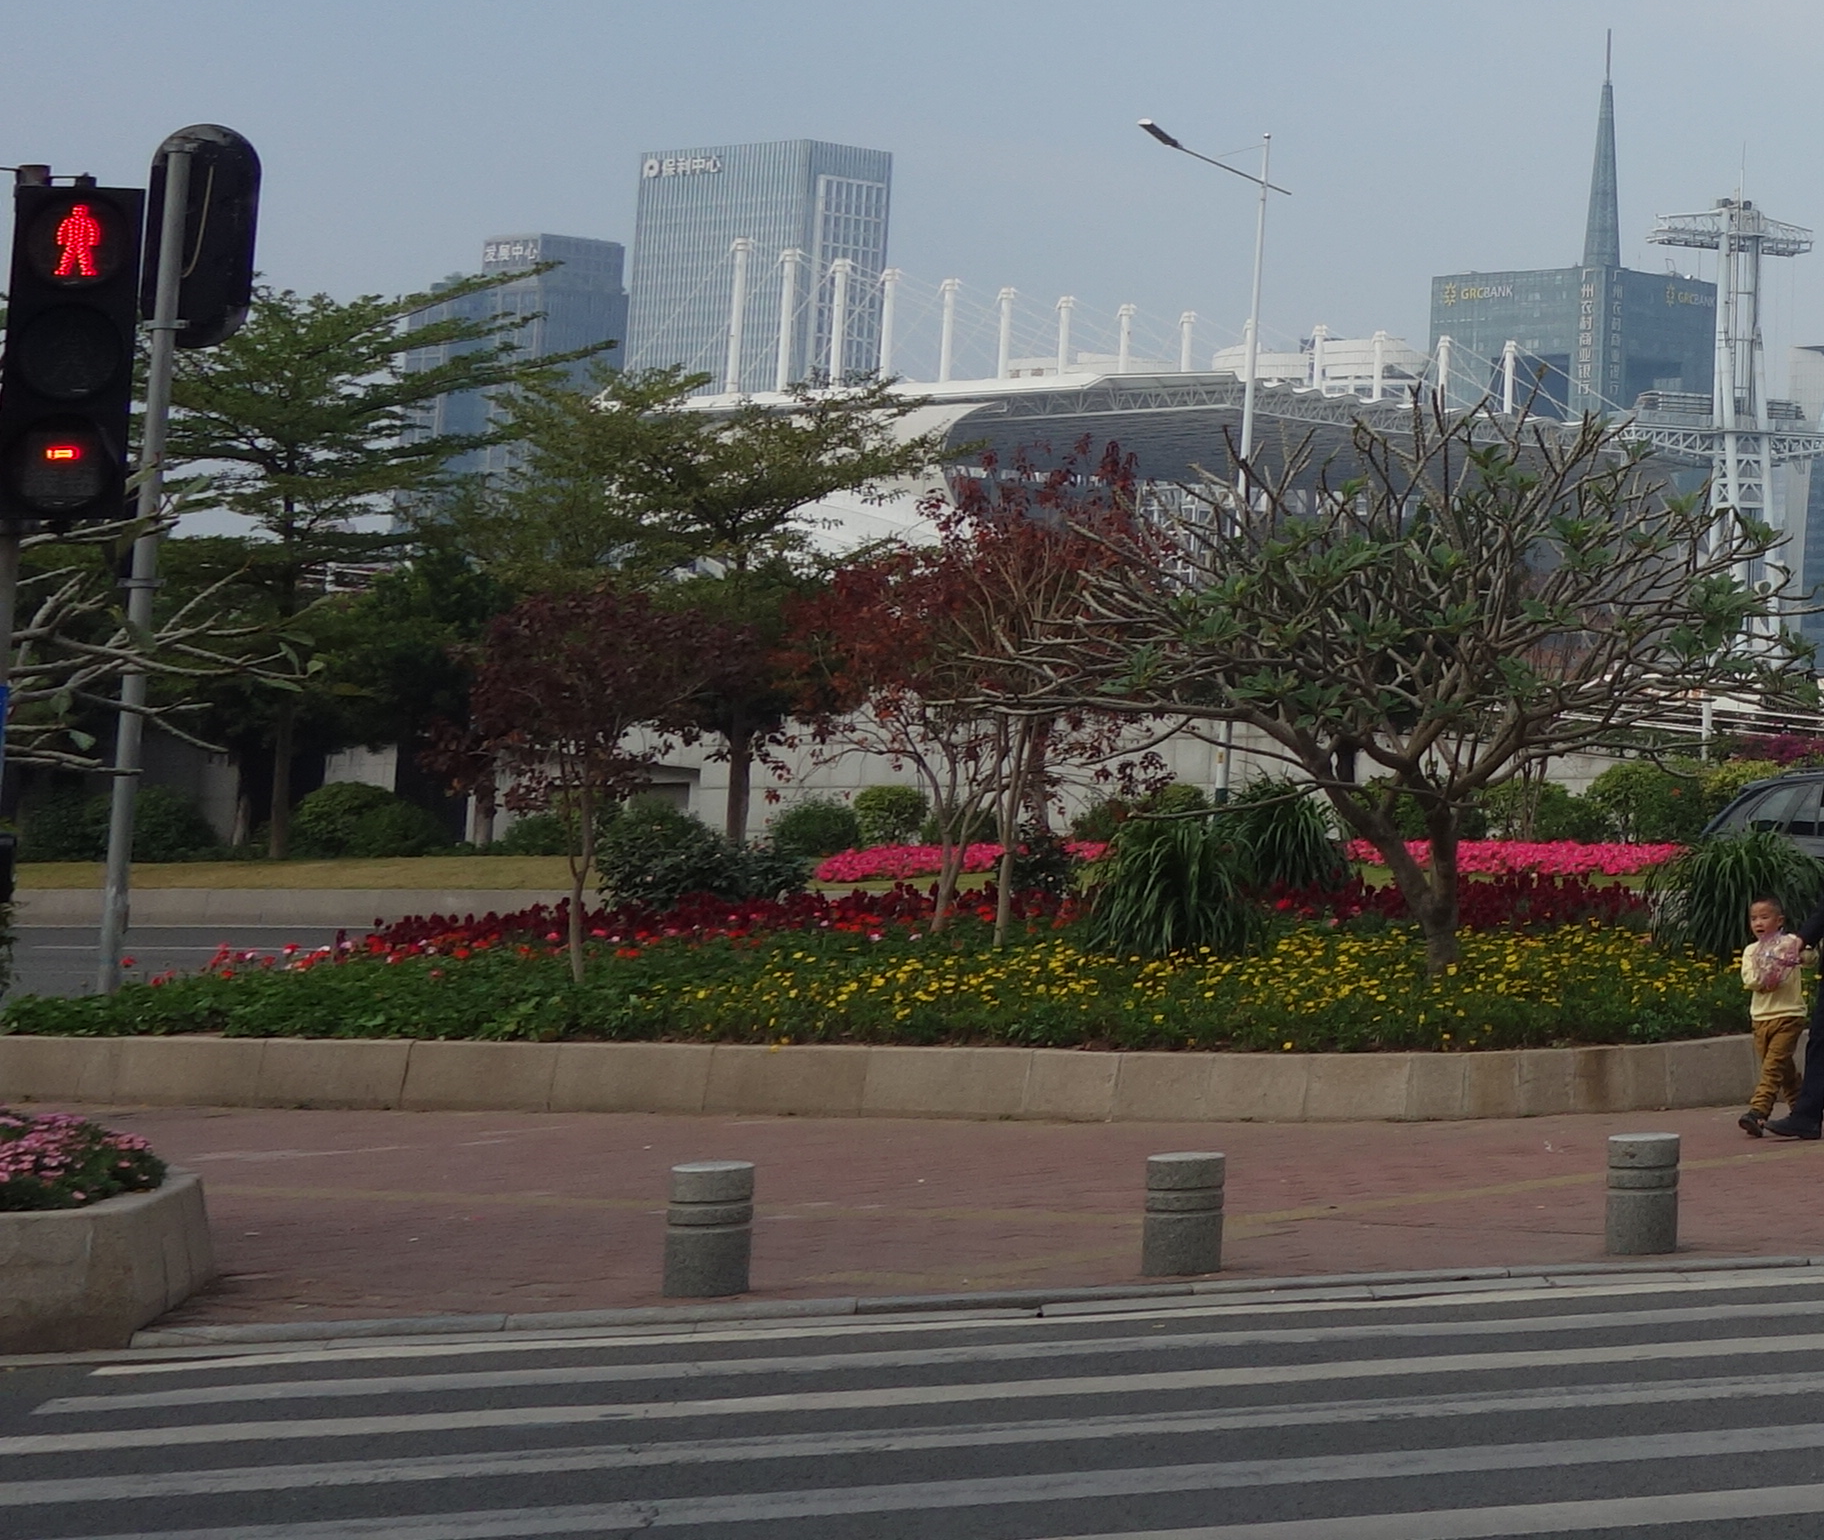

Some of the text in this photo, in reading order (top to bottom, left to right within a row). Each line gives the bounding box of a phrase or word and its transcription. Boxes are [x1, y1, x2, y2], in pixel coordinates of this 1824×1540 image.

[661, 156, 721, 178] 保利中心
[1460, 285, 1514, 300] GRCBANK
[1577, 268, 1595, 395] 广州农村商业银行
